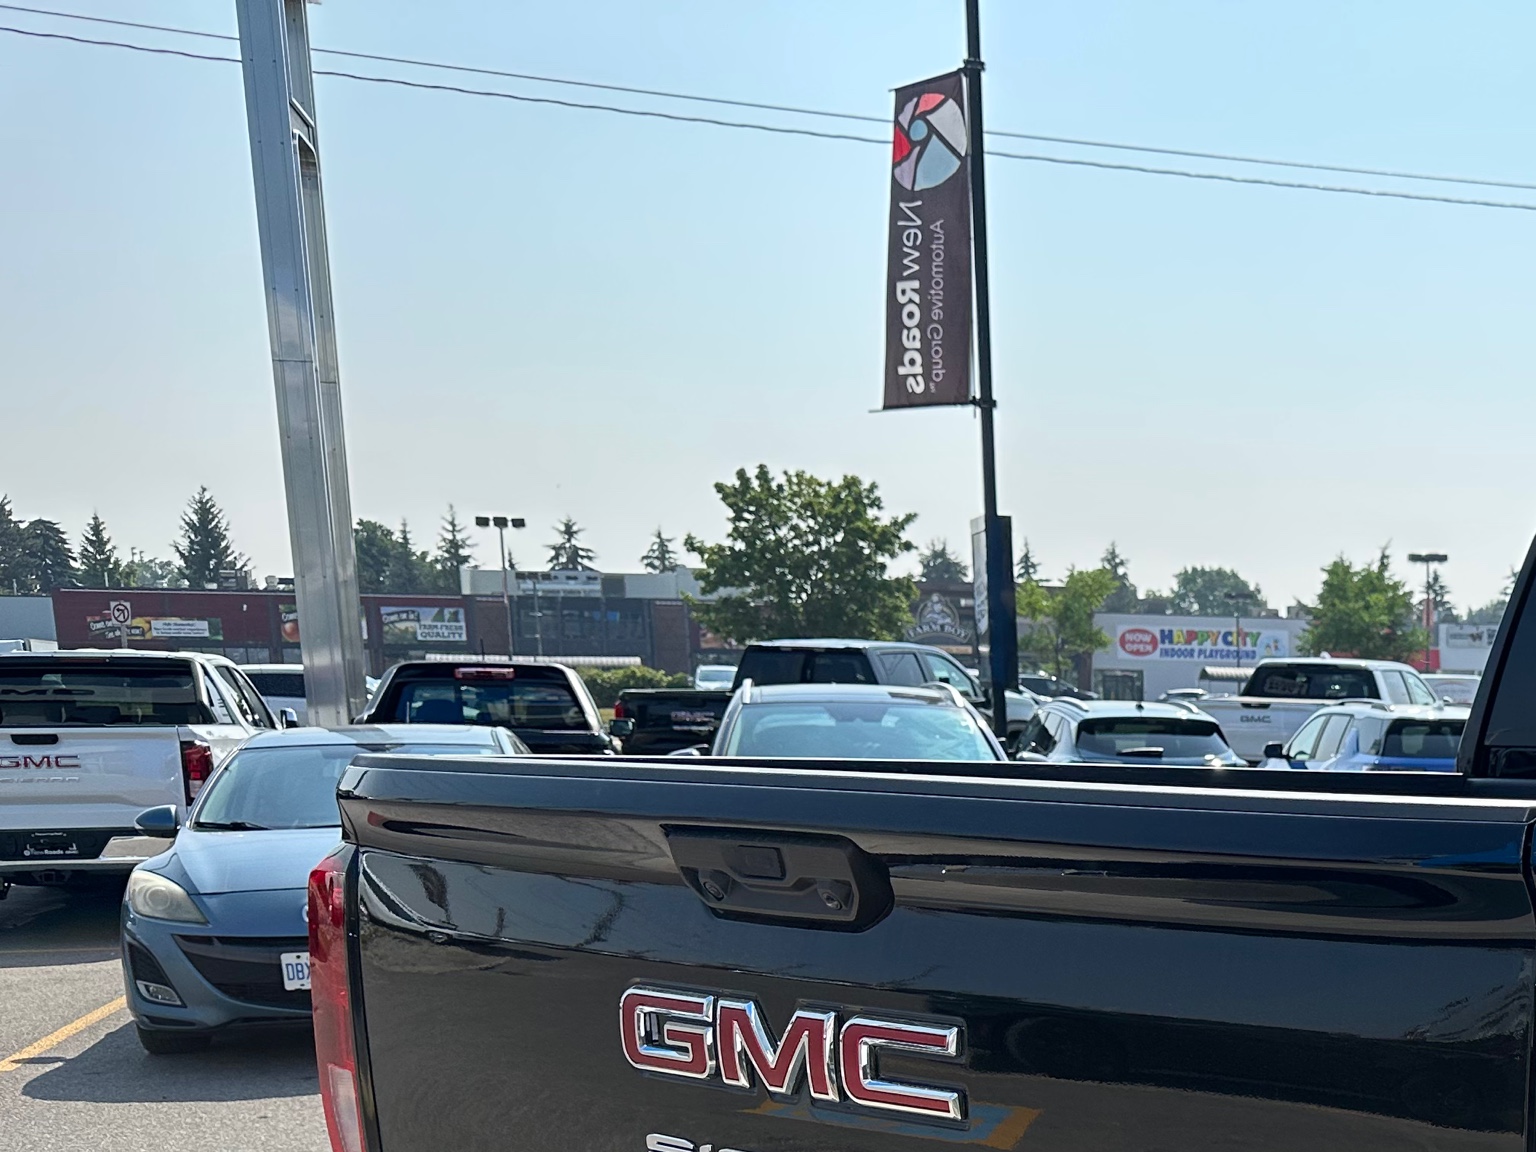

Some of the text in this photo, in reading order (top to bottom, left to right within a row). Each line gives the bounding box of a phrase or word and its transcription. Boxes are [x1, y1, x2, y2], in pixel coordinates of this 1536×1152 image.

[908, 621, 969, 639] FARM BOY
[1124, 633, 1152, 643] NOW
[1159, 626, 1262, 648] HAPPY CITY
[1125, 643, 1153, 652] OPEN
[1159, 649, 1257, 660] INDOOR PLAYGROUND
[1240, 715, 1271, 724] GMC
[0, 754, 81, 769] GMC
[619, 983, 968, 1121] GMC
